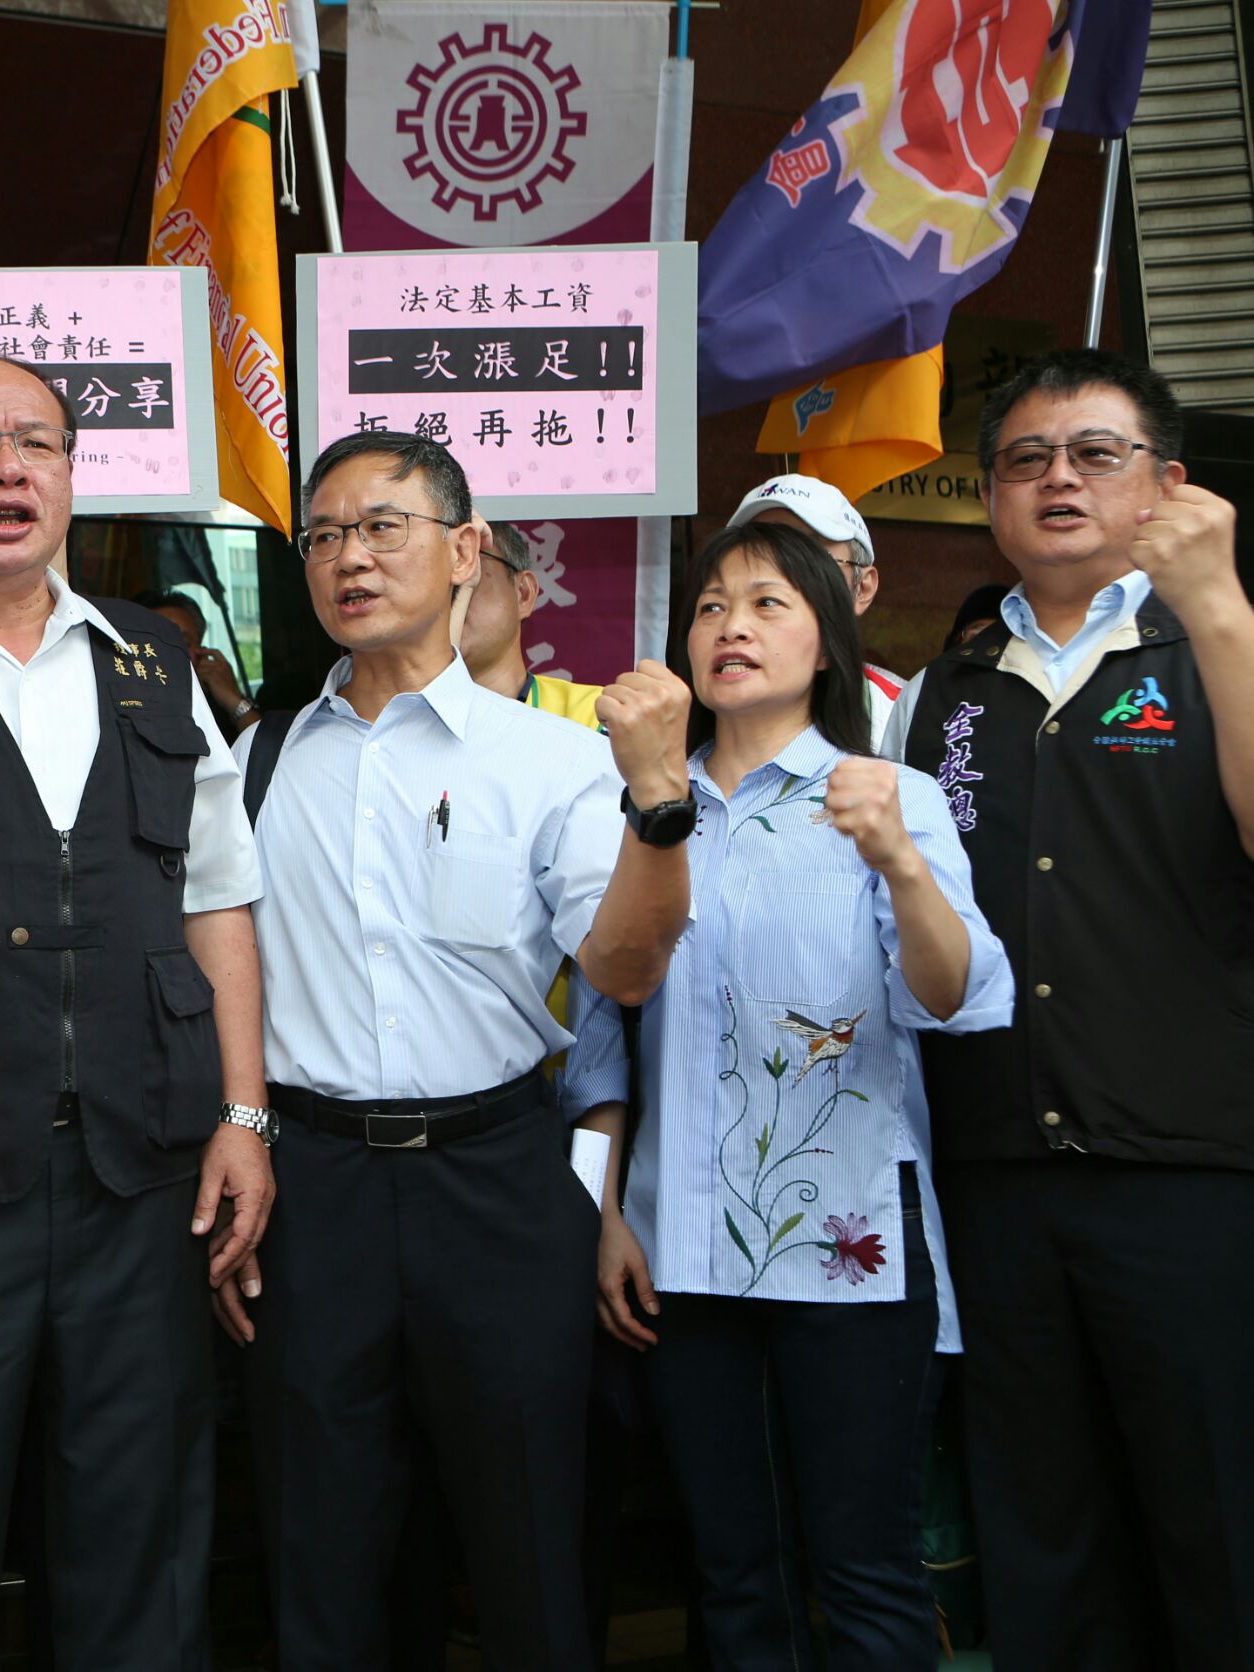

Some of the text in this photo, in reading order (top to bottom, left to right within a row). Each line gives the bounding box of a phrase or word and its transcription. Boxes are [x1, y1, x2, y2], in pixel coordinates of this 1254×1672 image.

[400, 282, 594, 314] 法定基本工資
[354, 339, 636, 380] 一次漲足!!
[233, 332, 289, 458] Unio
[936, 476, 966, 498] OF
